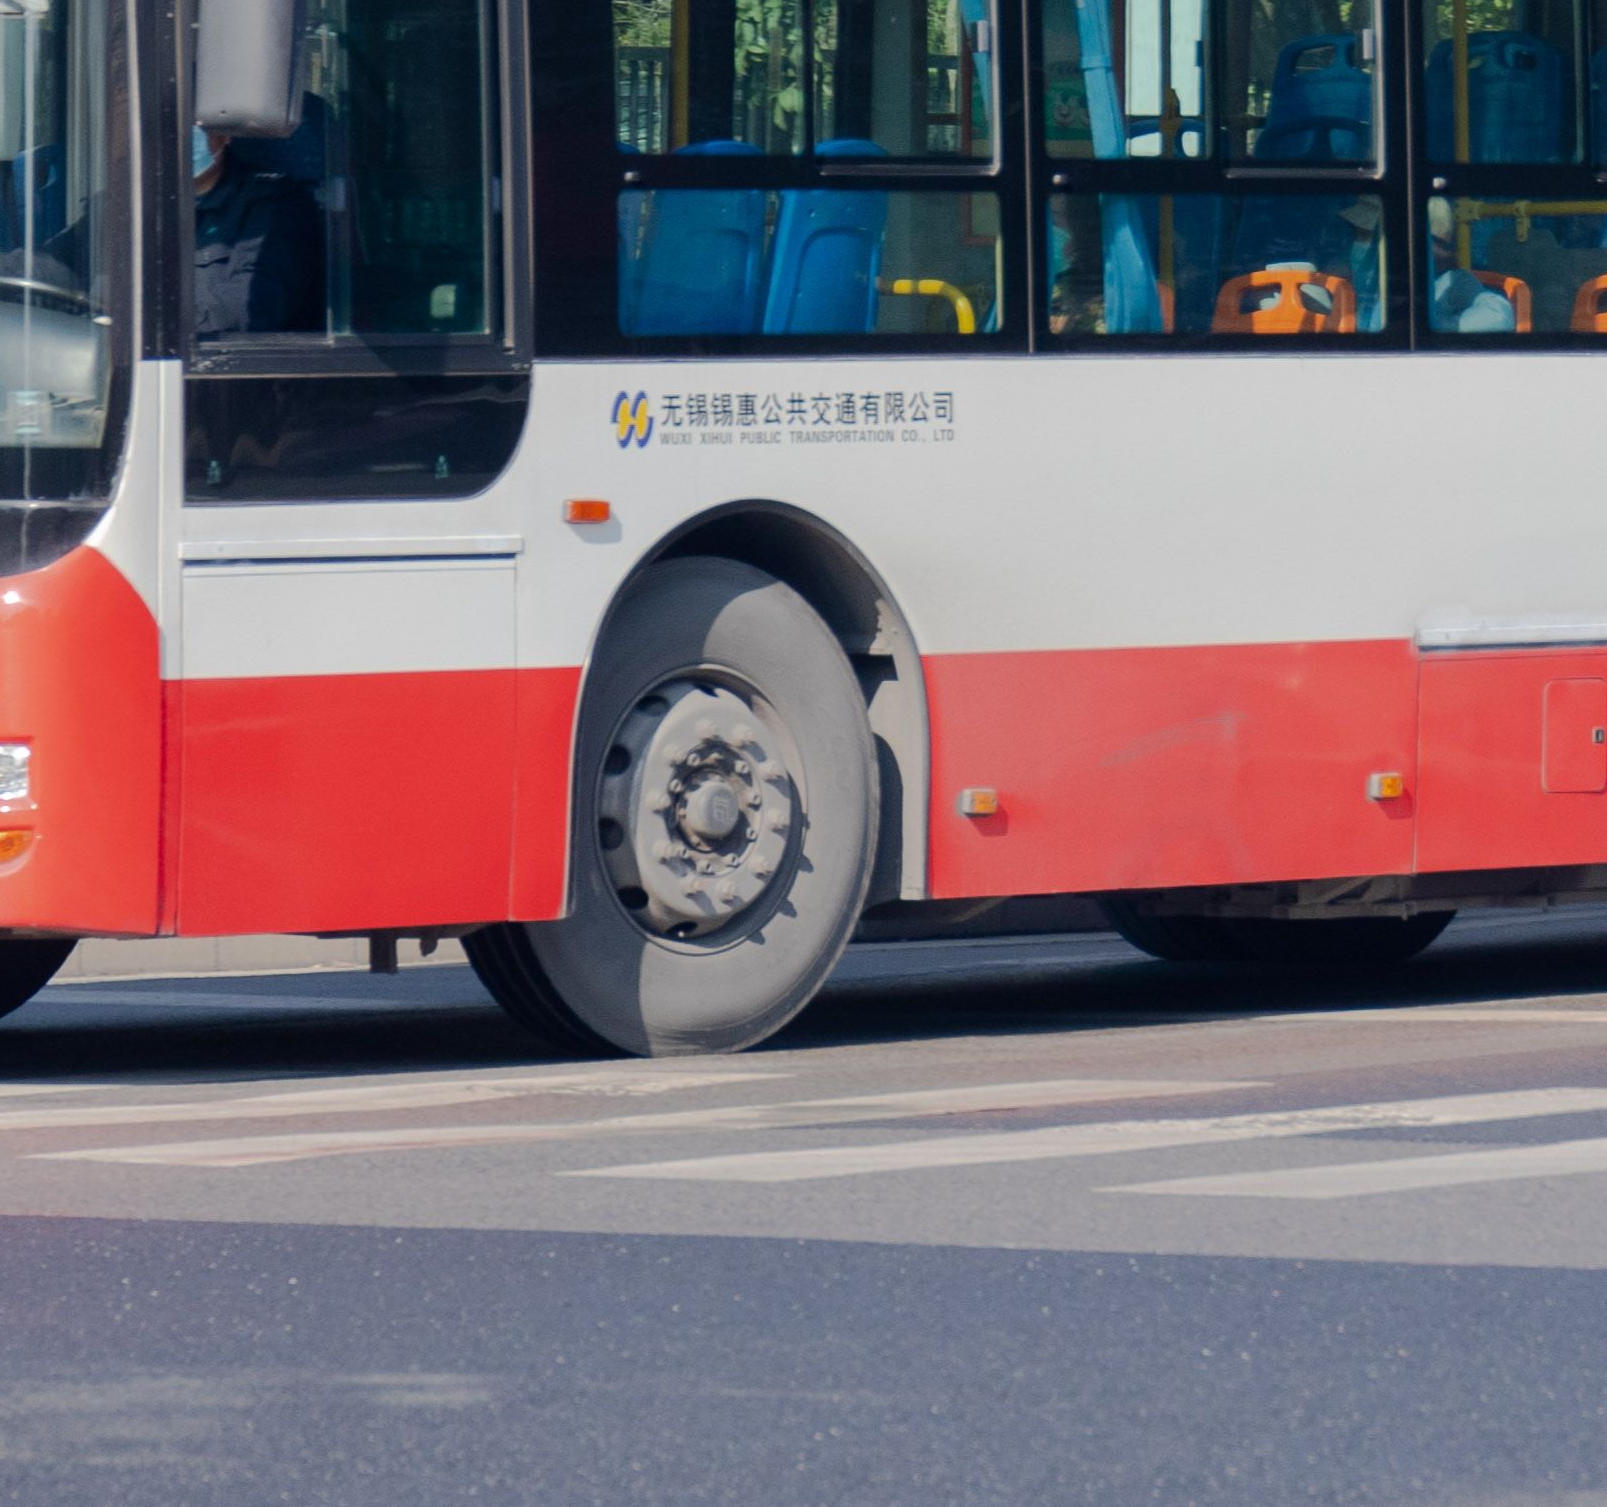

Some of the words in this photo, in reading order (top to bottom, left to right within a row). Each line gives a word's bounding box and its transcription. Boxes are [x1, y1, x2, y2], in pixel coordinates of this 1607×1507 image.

[660, 391, 956, 427] 无锡锡惠公共交通有限公司
[659, 432, 693, 446] WUXI
[699, 432, 733, 446] XIHUI
[740, 431, 782, 445] PUBLIC
[789, 430, 895, 444] TRANSPORTATION
[933, 429, 956, 443] LTD
